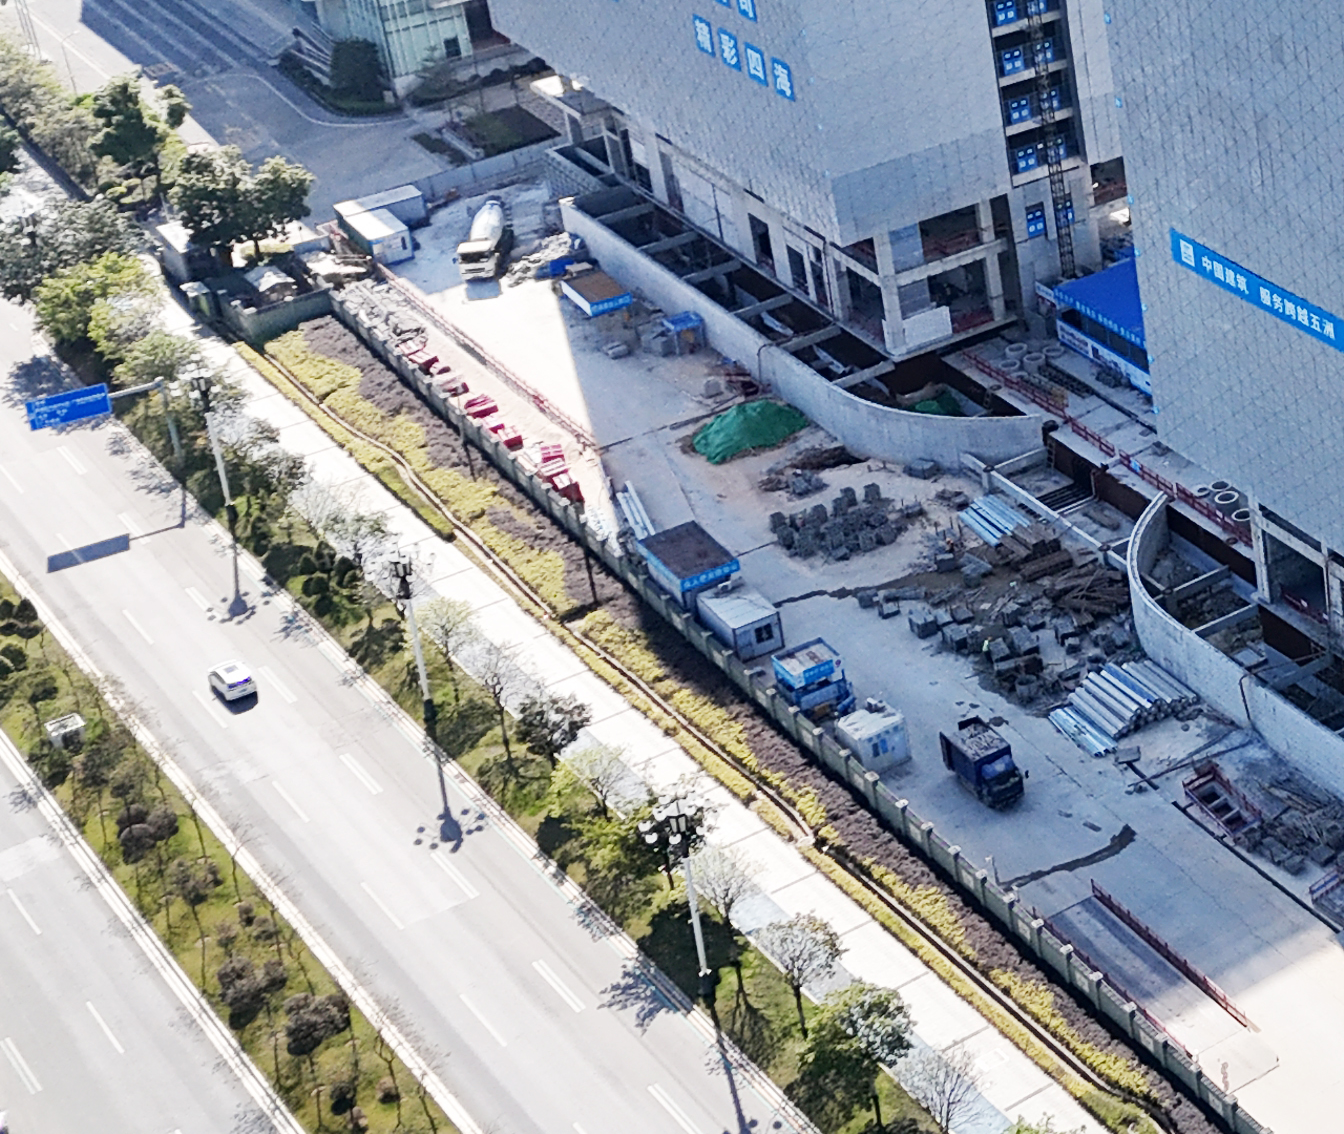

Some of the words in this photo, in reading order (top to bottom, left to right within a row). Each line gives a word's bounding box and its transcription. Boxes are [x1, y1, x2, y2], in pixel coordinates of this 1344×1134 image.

[1201, 255, 1249, 294] 中国建筑
[1259, 286, 1336, 341] 服务跨越五洲
